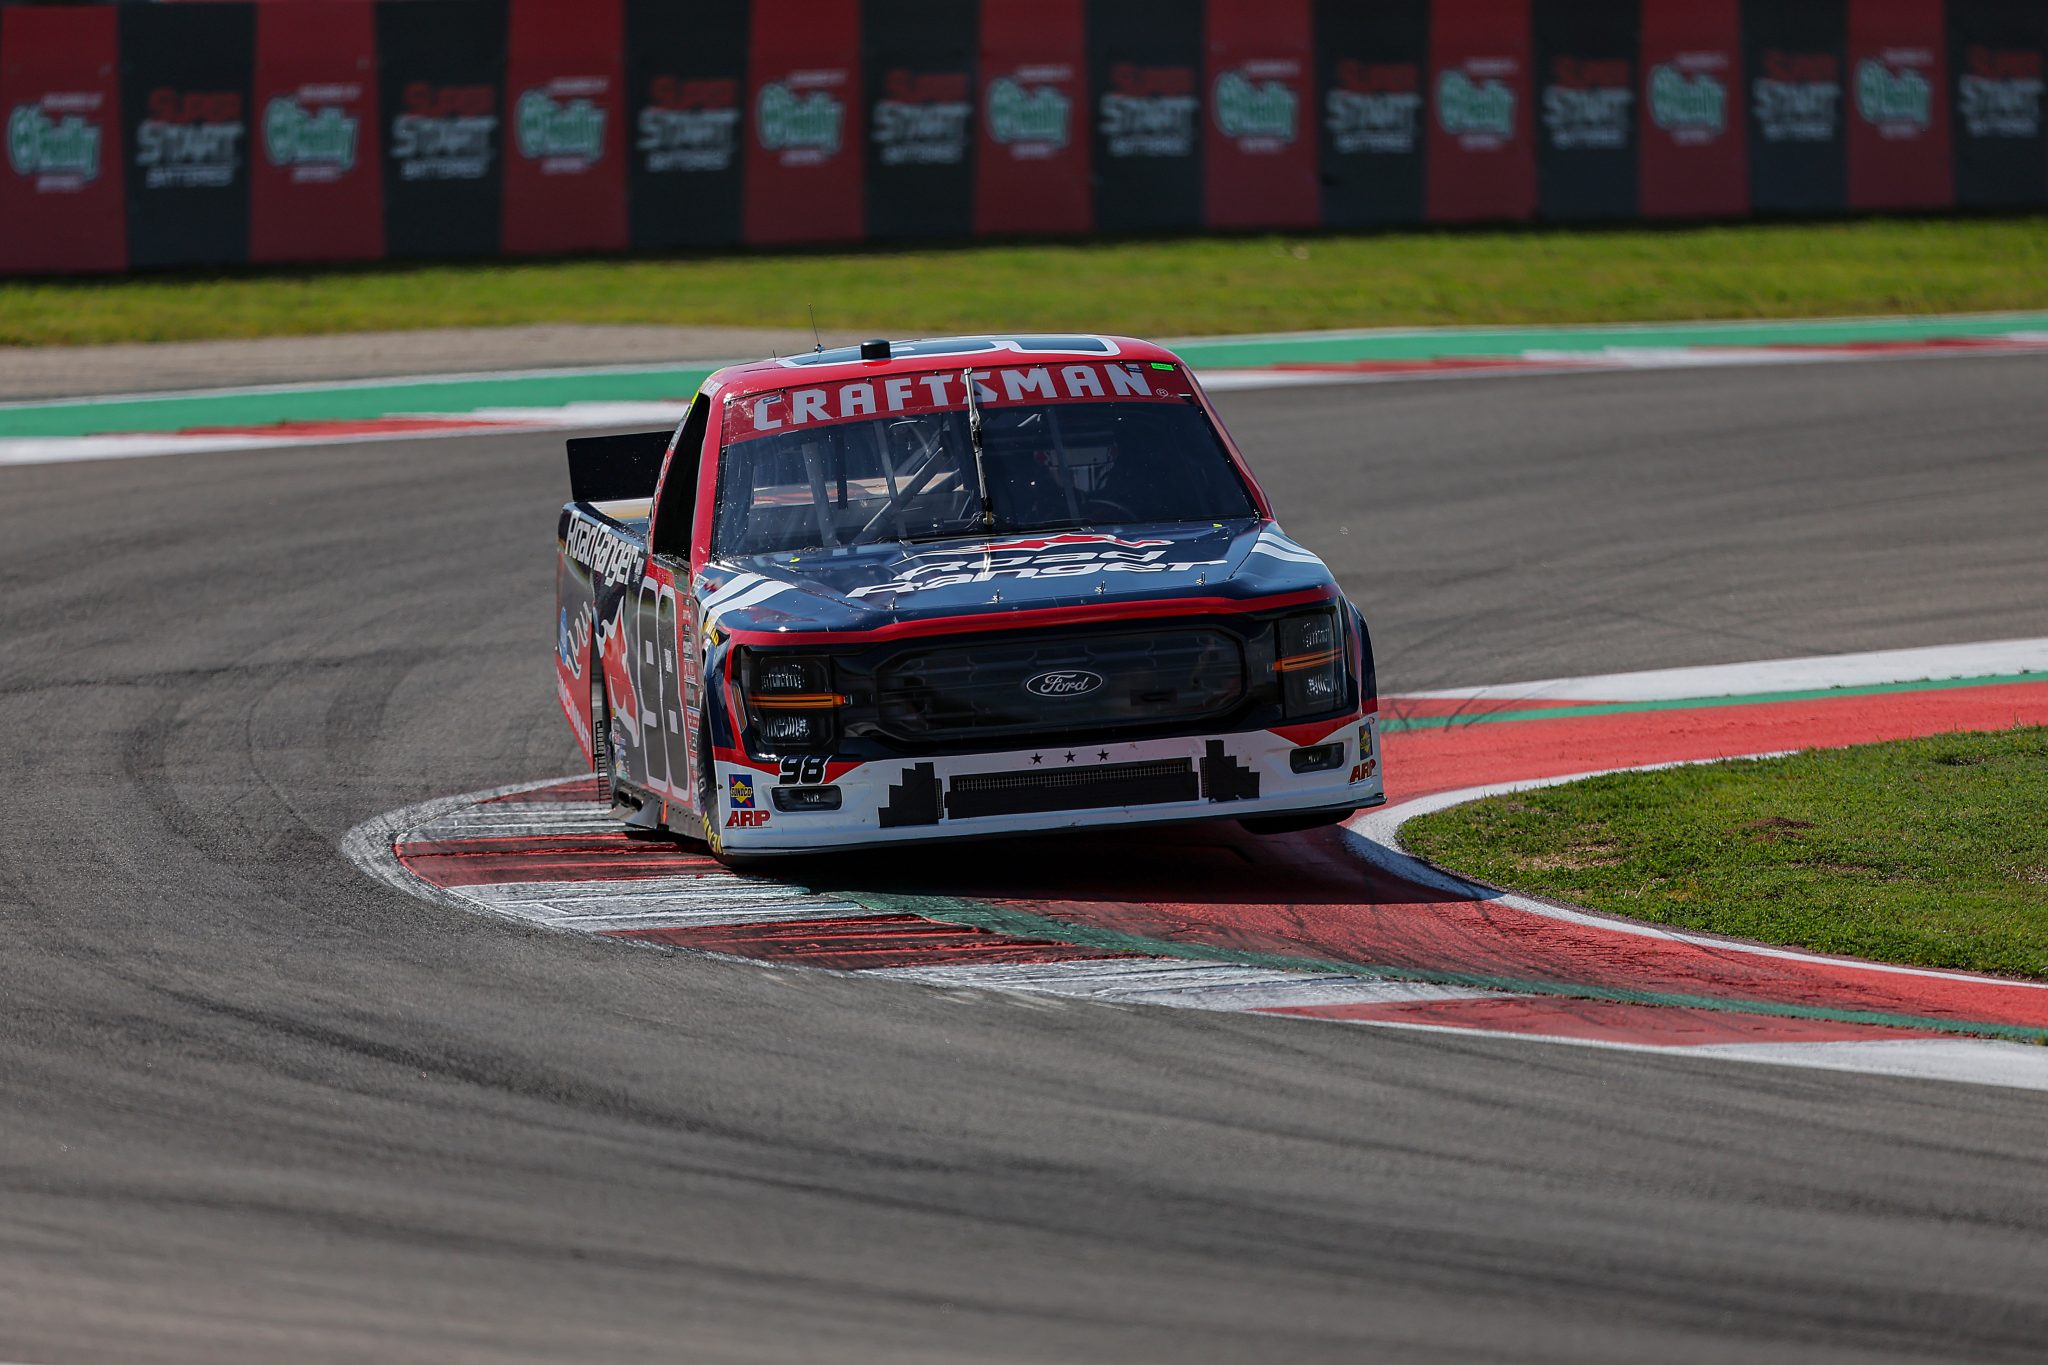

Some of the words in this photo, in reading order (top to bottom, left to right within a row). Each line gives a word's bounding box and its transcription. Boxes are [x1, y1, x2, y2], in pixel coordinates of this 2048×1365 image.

[753, 364, 1152, 431] CRAFTSMAN
[845, 560, 1228, 598] Ranger
[1040, 673, 1089, 693] Ford
[779, 755, 831, 785] 98
[1349, 759, 1376, 783] ARP
[730, 787, 752, 798] SUNOCO
[726, 810, 770, 826] ARP
